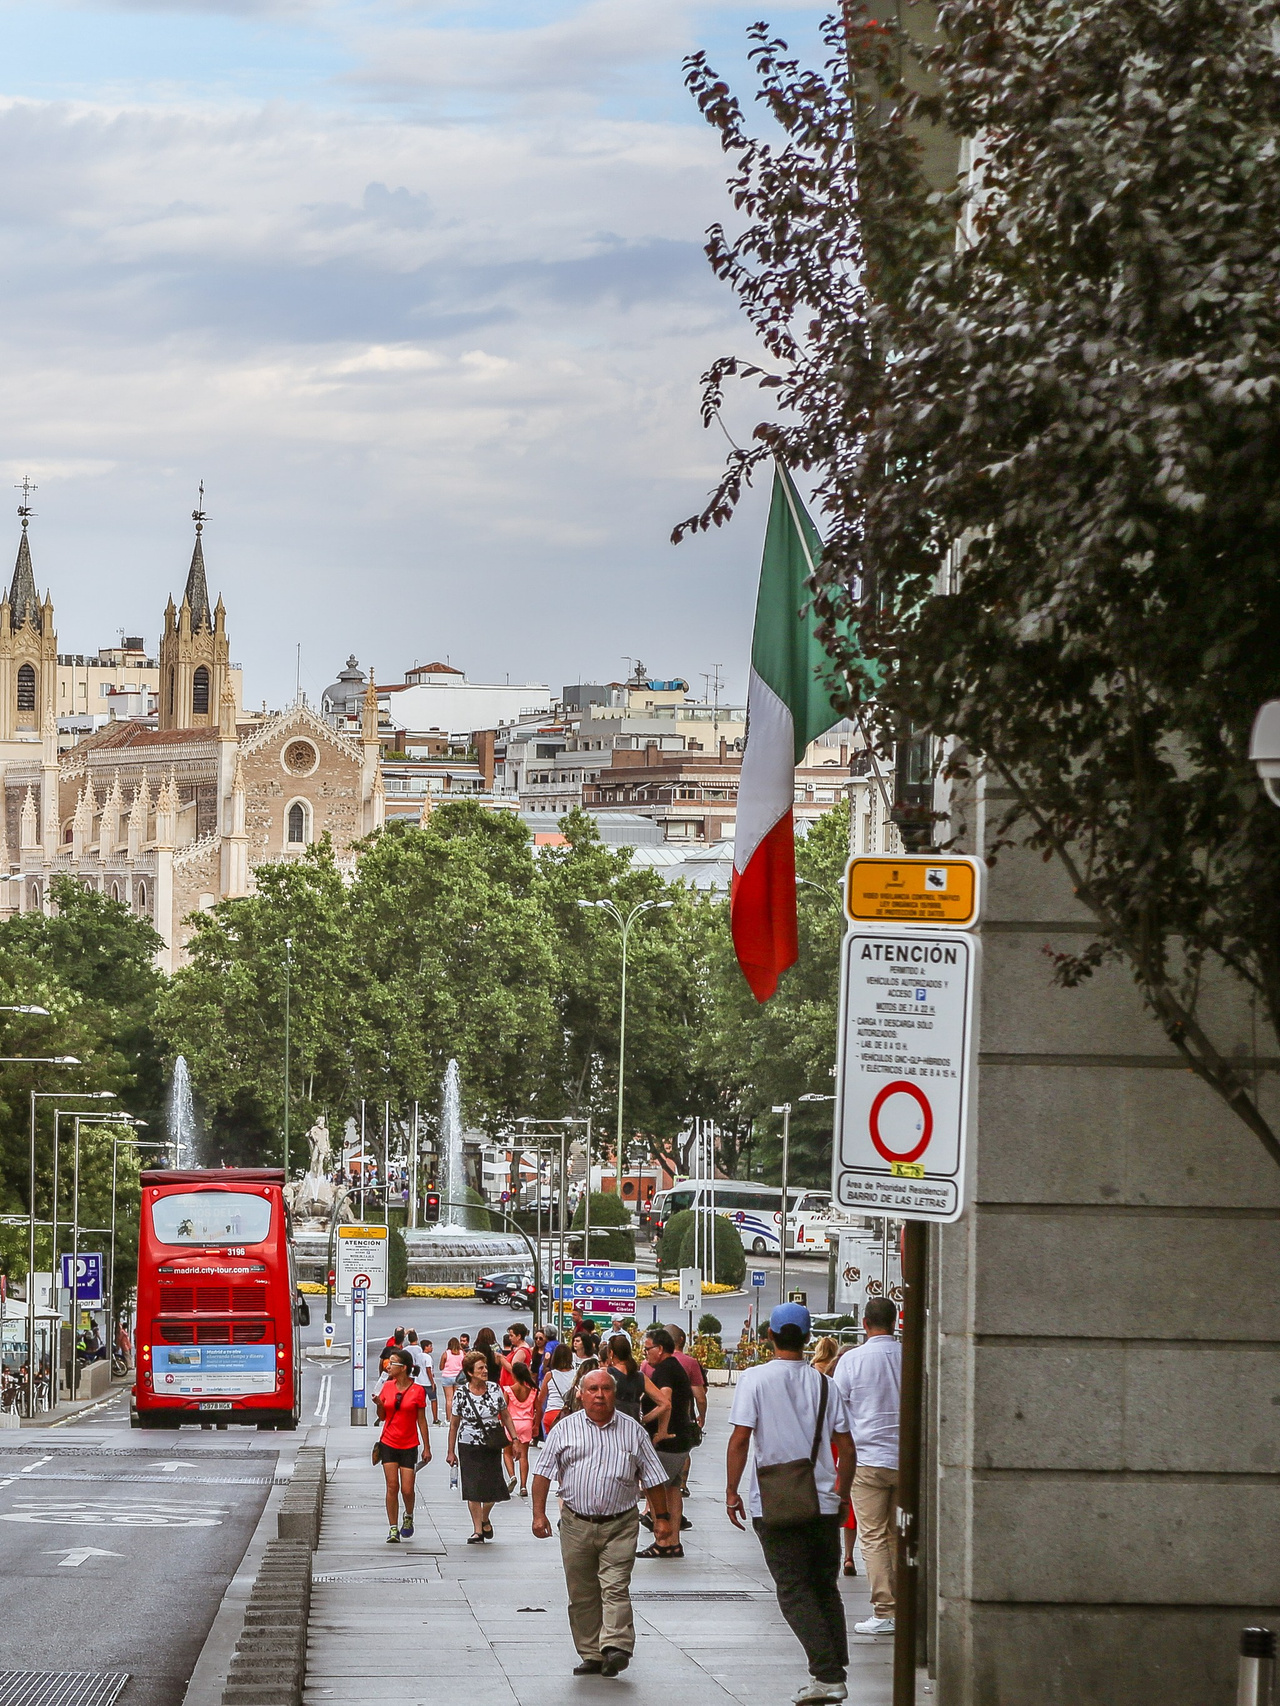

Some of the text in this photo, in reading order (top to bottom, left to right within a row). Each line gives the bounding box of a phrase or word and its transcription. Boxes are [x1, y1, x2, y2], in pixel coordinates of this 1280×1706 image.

[861, 943, 957, 965] ATENCIÓN
[889, 965, 919, 975] PERMITIDO
[901, 978, 943, 989] AUTORIZADOS
[888, 989, 913, 998] ACCESO
[876, 1002, 898, 1012] MOTOS
[898, 1003, 907, 1012] DE
[914, 1004, 919, 1012] A
[857, 1017, 877, 1026] CARGA
[884, 1019, 916, 1028] DESCARGA
[874, 1041, 882, 1050] DE
[919, 1067, 928, 1077] DE
[863, 1181, 874, 1190] de
[875, 1182, 907, 1194] Prioridad
[908, 1184, 950, 1197] Residencial
[846, 1190, 947, 1209] BARRIO DE LAS LETRAS
[227, 1248, 246, 1256] 3196
[173, 1265, 250, 1275] madrid.city-tour.com
[609, 1286, 634, 1294] Valencia
